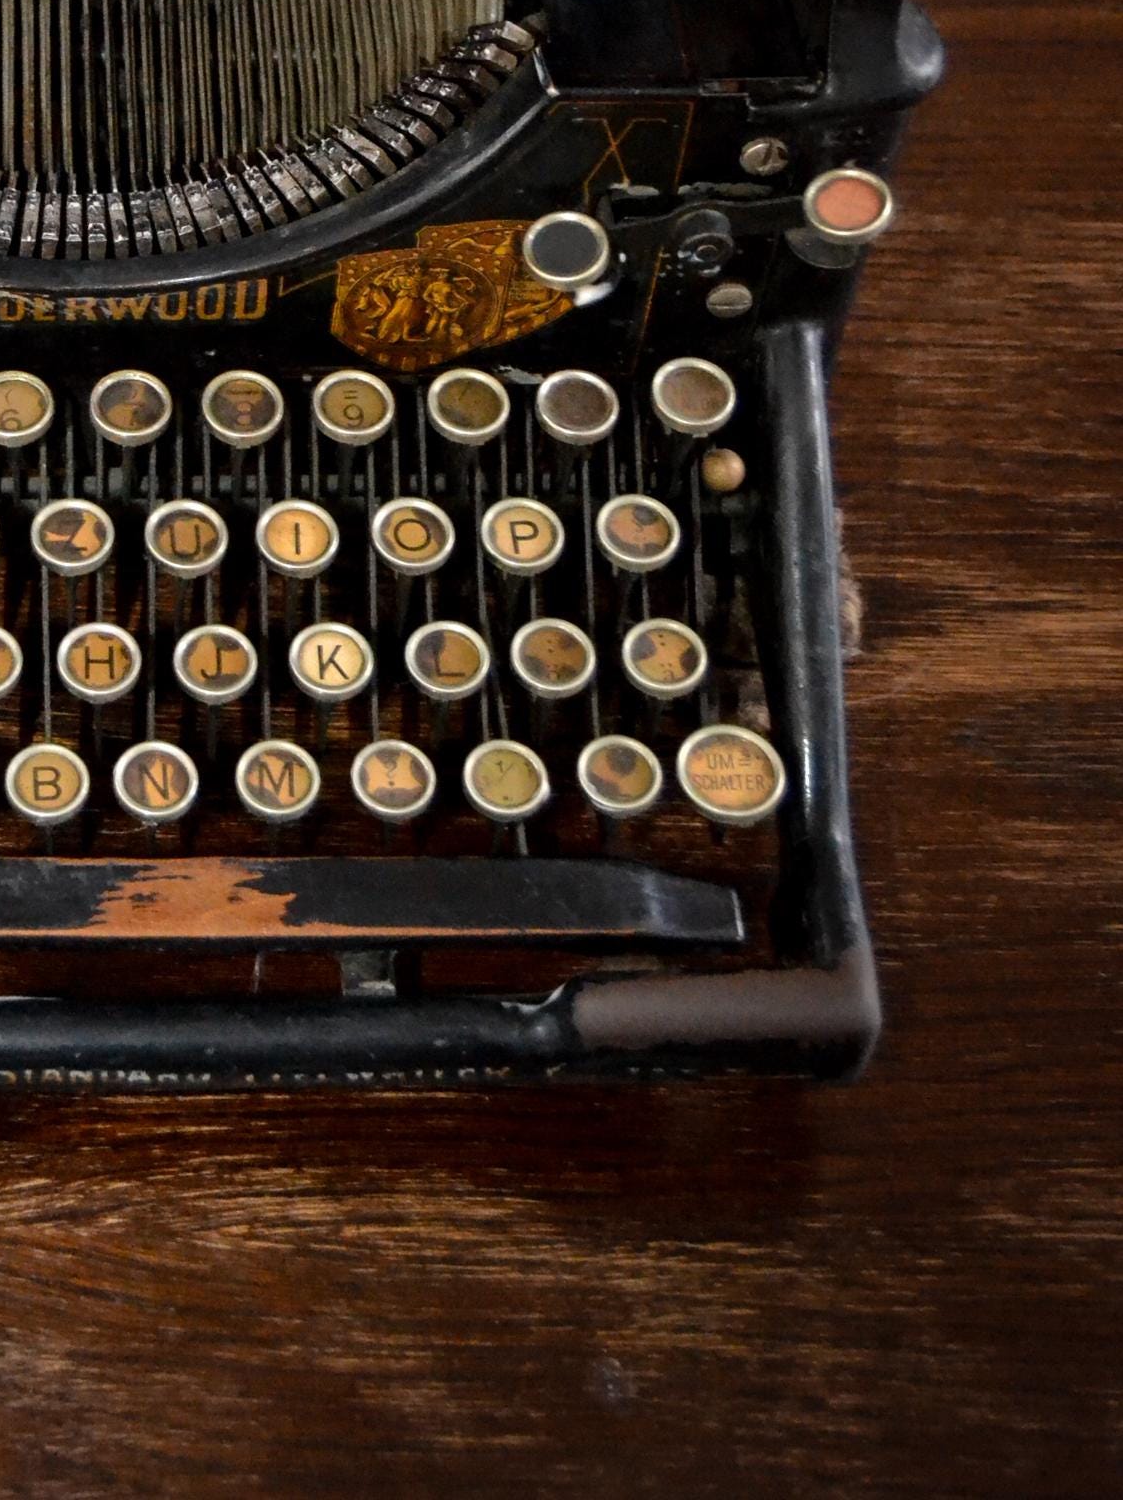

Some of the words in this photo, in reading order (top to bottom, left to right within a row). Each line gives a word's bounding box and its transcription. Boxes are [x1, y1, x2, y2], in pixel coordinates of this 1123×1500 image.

[0, 408, 22, 431] 6
[343, 403, 363, 428] 9
[167, 523, 201, 557] U
[293, 521, 302, 556] I
[393, 518, 431, 552] O
[510, 519, 539, 554] P
[83, 645, 115, 680] H
[200, 646, 222, 680] J
[317, 643, 350, 681] K
[32, 765, 62, 801] B
[138, 762, 171, 801] N
[258, 760, 296, 799] M
[693, 772, 765, 793] SCHALTER
